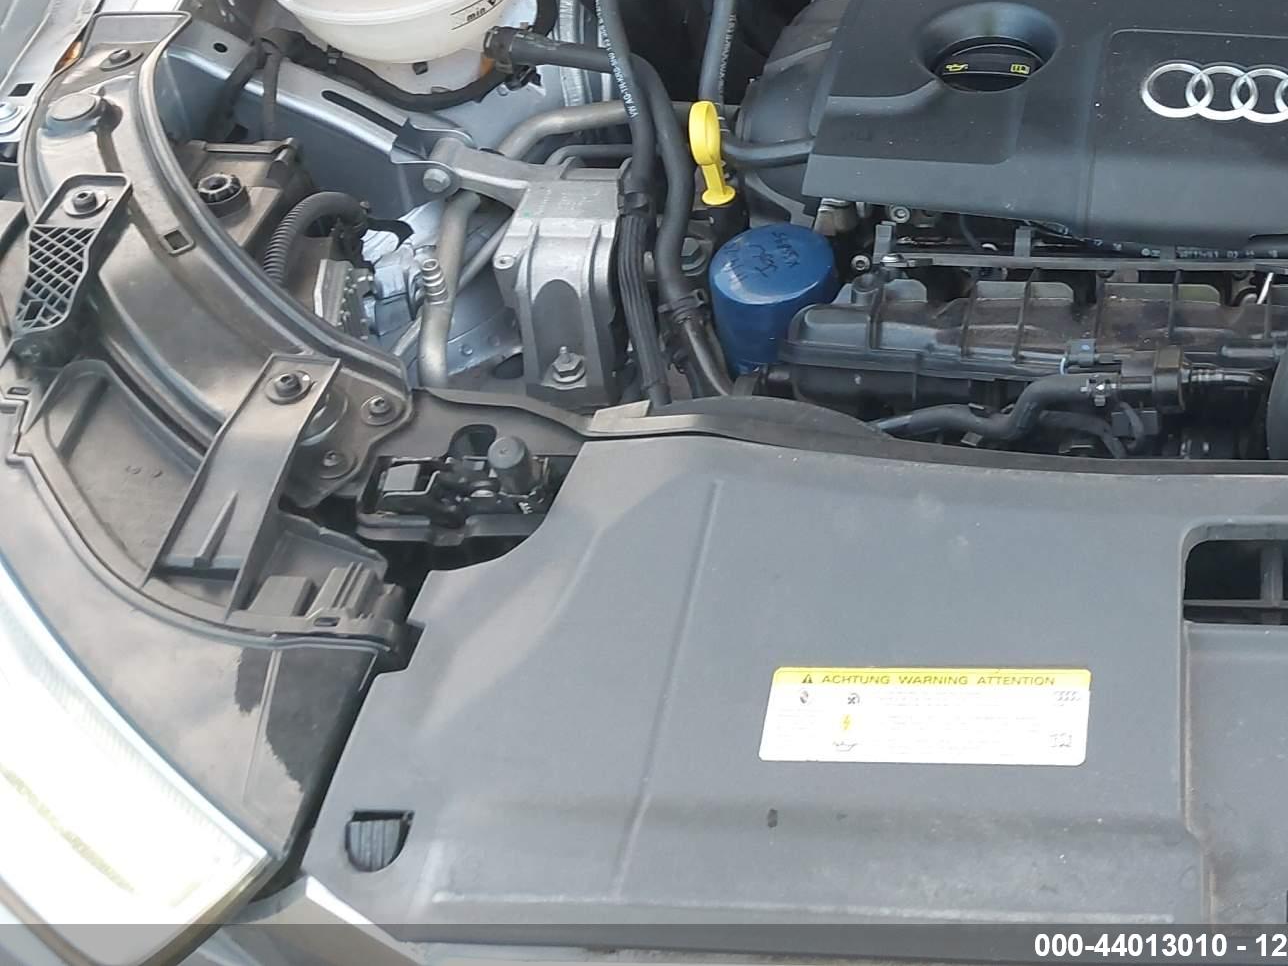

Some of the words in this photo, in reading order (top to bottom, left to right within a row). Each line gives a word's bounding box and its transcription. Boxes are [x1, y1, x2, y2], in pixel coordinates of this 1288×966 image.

[466, 7, 486, 22] min
[822, 675, 891, 685] ACHTUNG
[898, 675, 969, 685] WARNING
[977, 676, 1056, 686] ATTENTION
